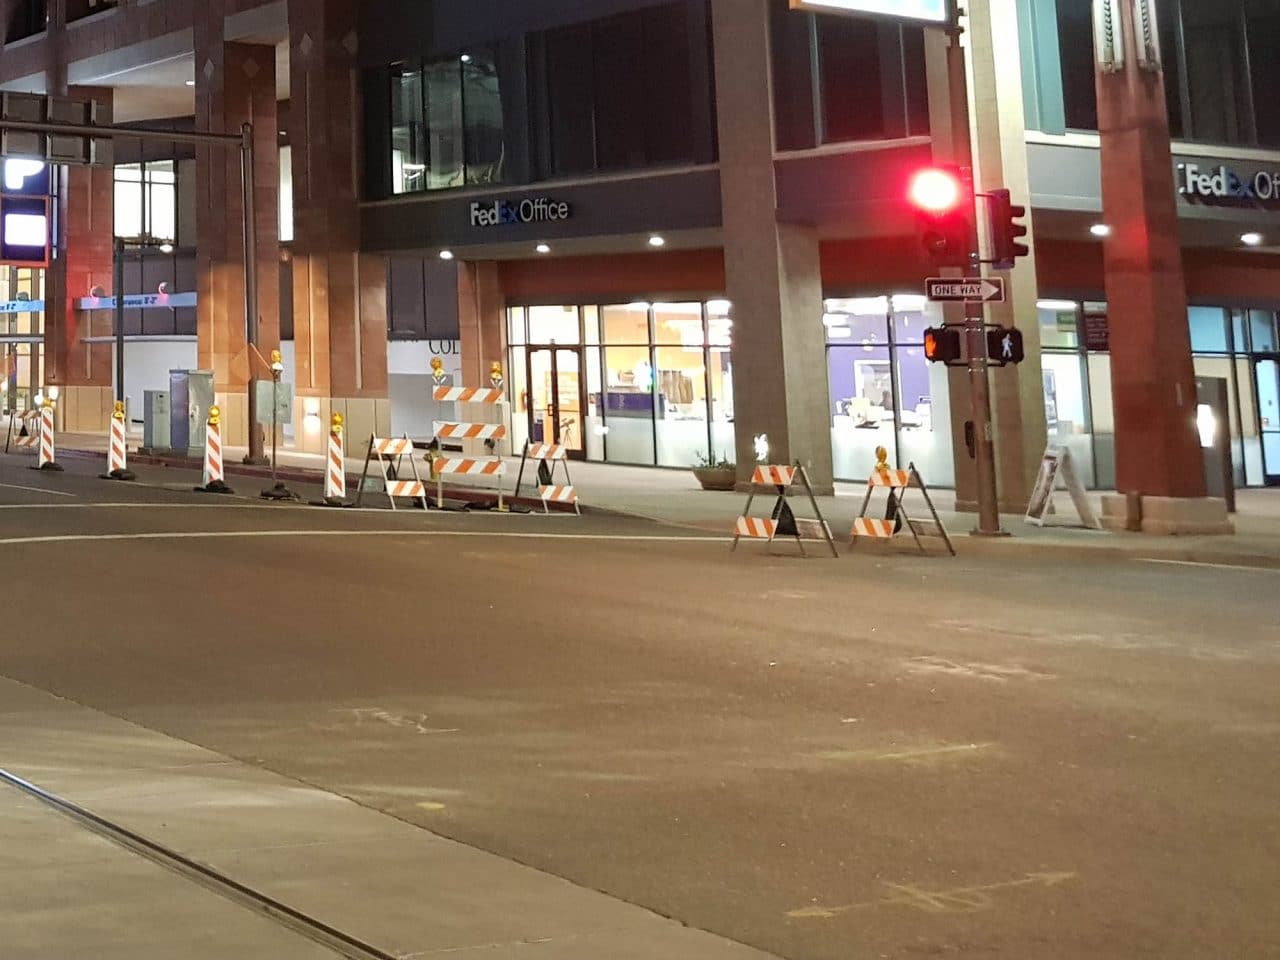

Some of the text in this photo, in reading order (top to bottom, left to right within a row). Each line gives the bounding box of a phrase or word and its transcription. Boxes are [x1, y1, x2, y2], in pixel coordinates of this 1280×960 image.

[1185, 163, 1254, 197] FedEx
[470, 198, 568, 226] FedEx Office
[934, 285, 982, 295] ONE WAY
